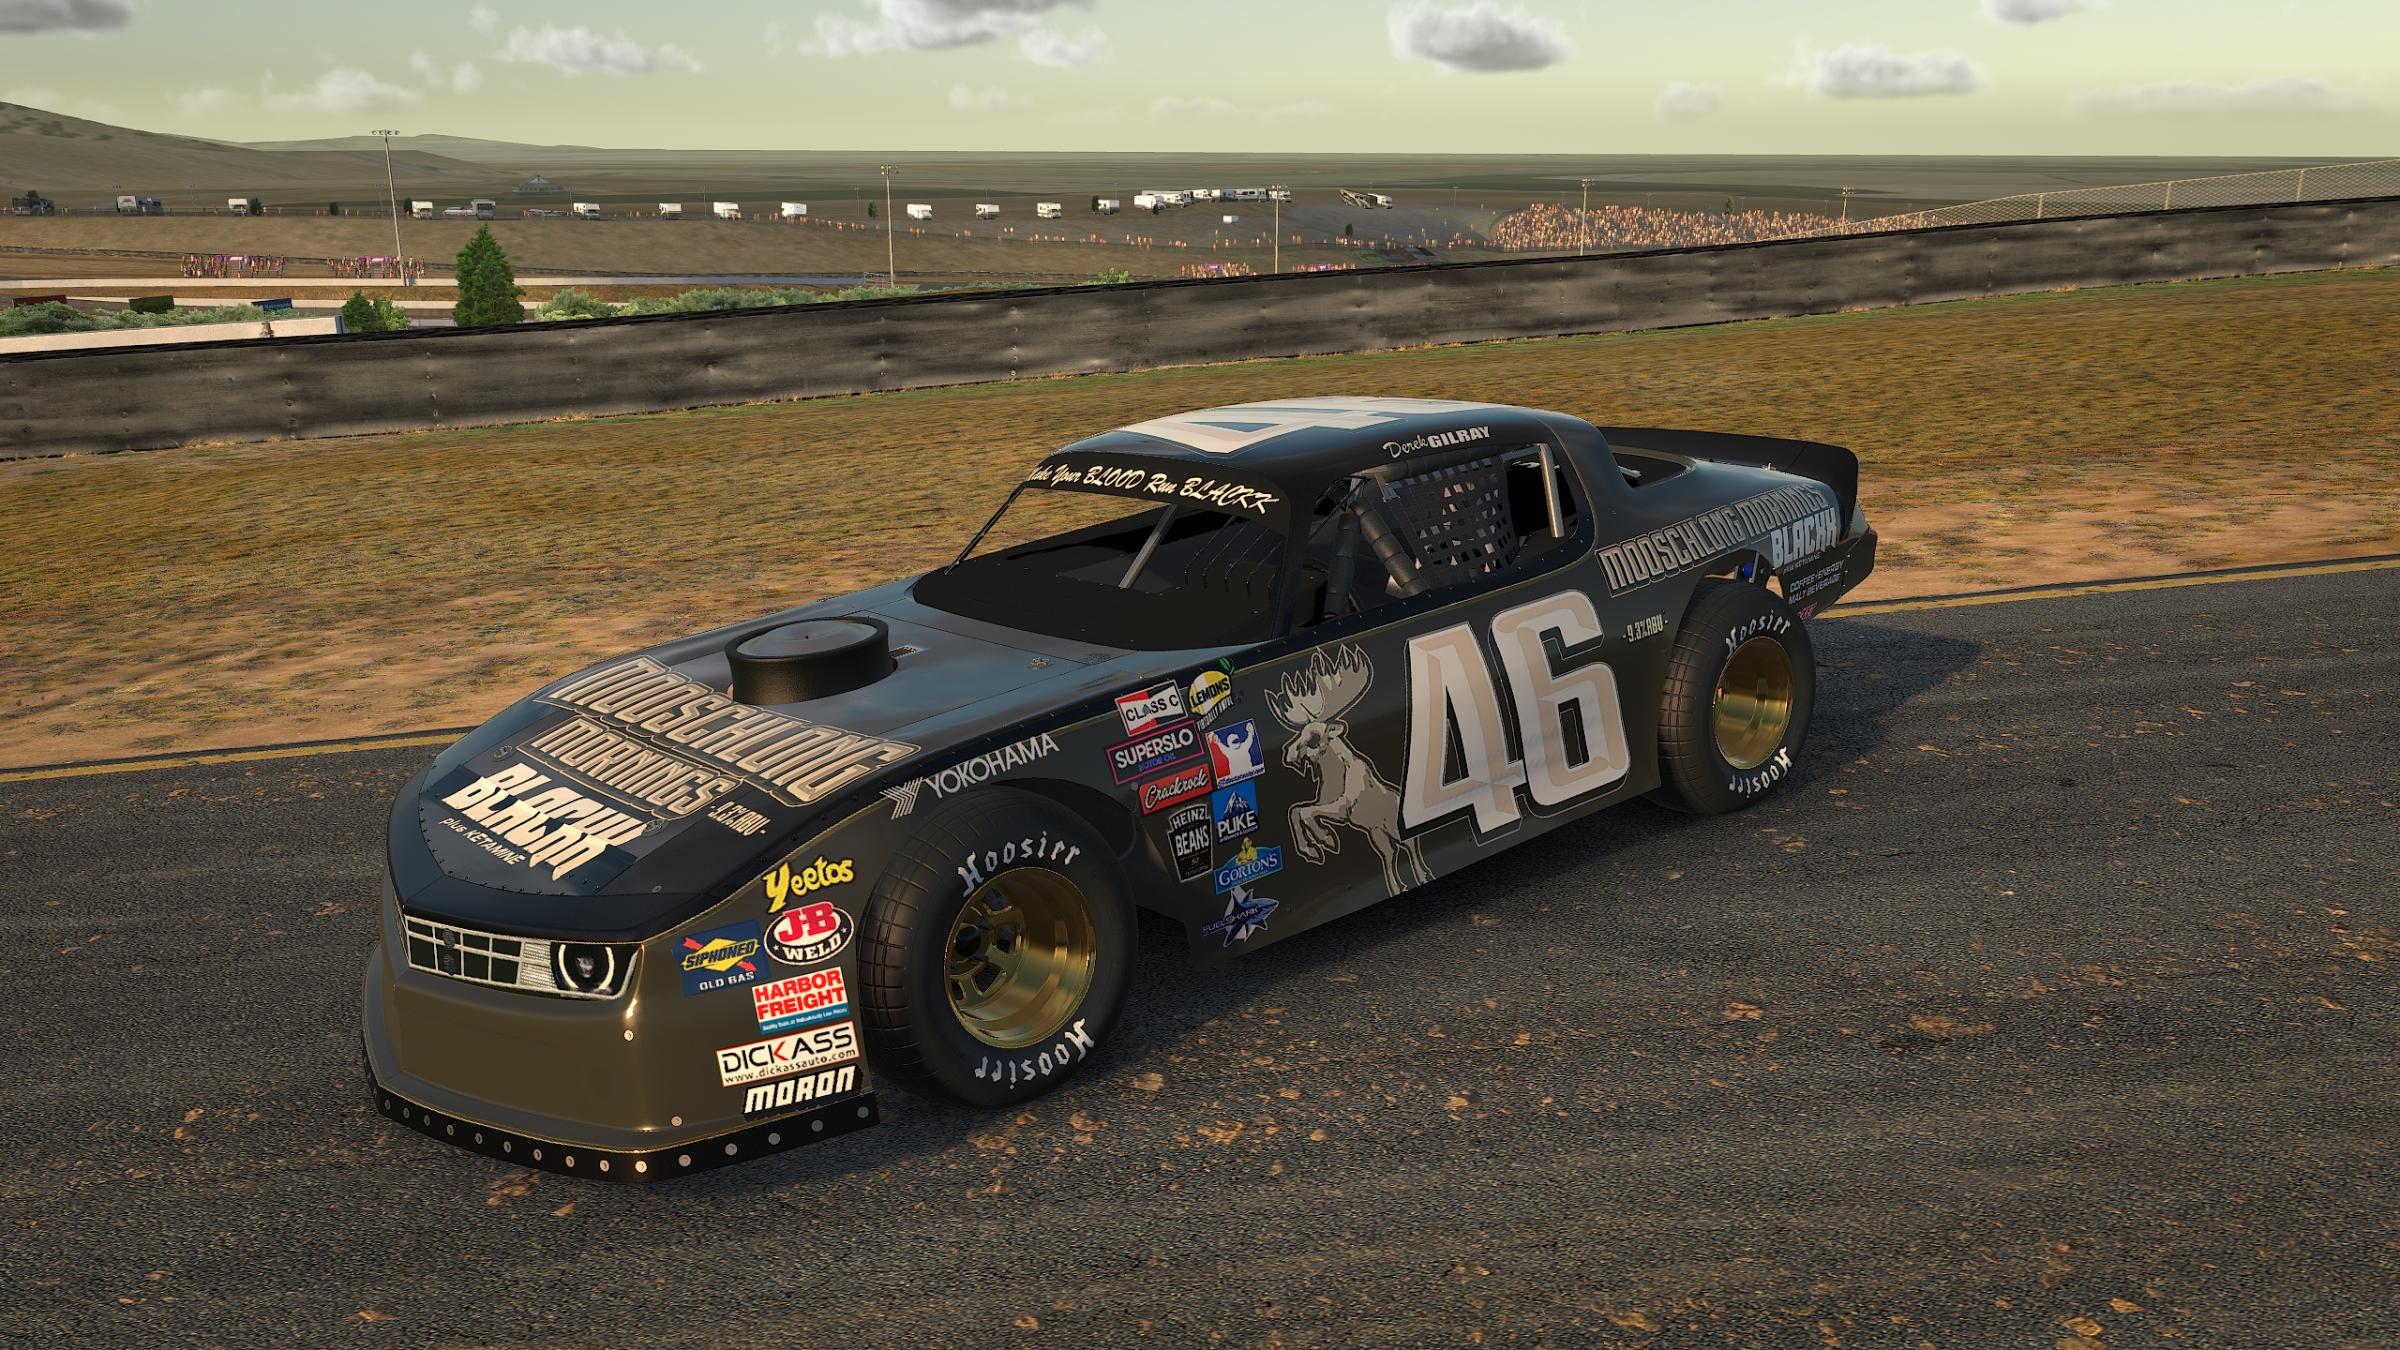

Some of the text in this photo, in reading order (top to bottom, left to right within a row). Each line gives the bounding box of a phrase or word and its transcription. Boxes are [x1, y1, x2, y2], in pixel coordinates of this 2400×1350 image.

[1383, 426, 1490, 458] Derek GILRAY
[1050, 463, 1081, 487] Your
[1083, 466, 1144, 490] BLOOD
[1143, 473, 1177, 494] Run
[1179, 477, 1280, 515] BLACKK
[1725, 609, 1791, 657] Hoosier
[1125, 694, 1179, 721] CLASS C
[1190, 678, 1230, 707] LEMONS
[1401, 589, 1632, 835] 46
[531, 718, 733, 815] MORNINGS
[922, 733, 1060, 799] YOKOHAMA
[1115, 728, 1194, 769] SUPERSLO
[1144, 768, 1208, 809] Crackrock
[1728, 745, 1793, 799] Hoosier
[1172, 807, 1205, 830] HEINZ
[1217, 810, 1257, 838] PUKE
[438, 817, 527, 866] plus KETAMINE
[1175, 824, 1210, 857] BEANS
[763, 856, 855, 912] Yeetos
[957, 831, 1081, 897] Hoosier
[1218, 852, 1278, 887] GORTON'S
[684, 940, 756, 969] SIPHONED
[782, 936, 842, 961] WELD
[699, 978, 725, 991] OLD
[754, 969, 843, 1003] HARBOR
[757, 986, 846, 1020] FREIGHT
[721, 1026, 854, 1074] DICKASS
[724, 1048, 857, 1084] www.dickassauto.com
[974, 1017, 1096, 1090] Hoosier
[743, 1065, 856, 1114] MORON
